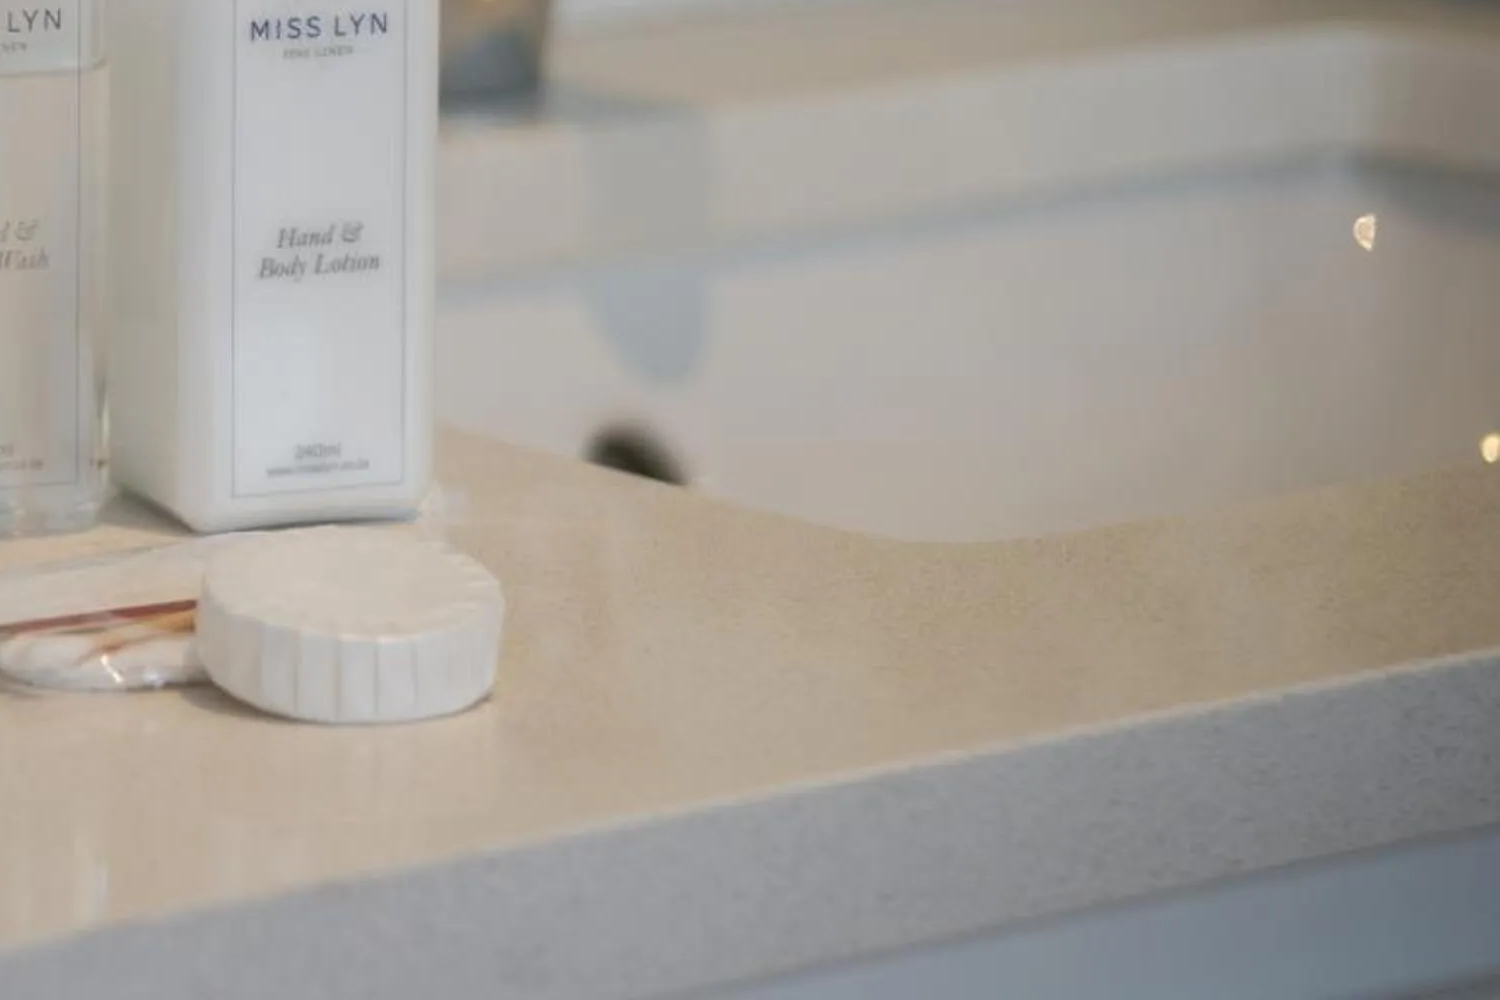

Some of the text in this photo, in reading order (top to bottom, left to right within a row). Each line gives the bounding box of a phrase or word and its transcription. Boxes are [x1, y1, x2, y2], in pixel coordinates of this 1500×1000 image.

[7, 7, 62, 33] LYN
[250, 12, 389, 41] MISS LYN
[15, 219, 39, 242] &
[276, 219, 365, 249] Hand &
[259, 251, 381, 283] Body Lotion
